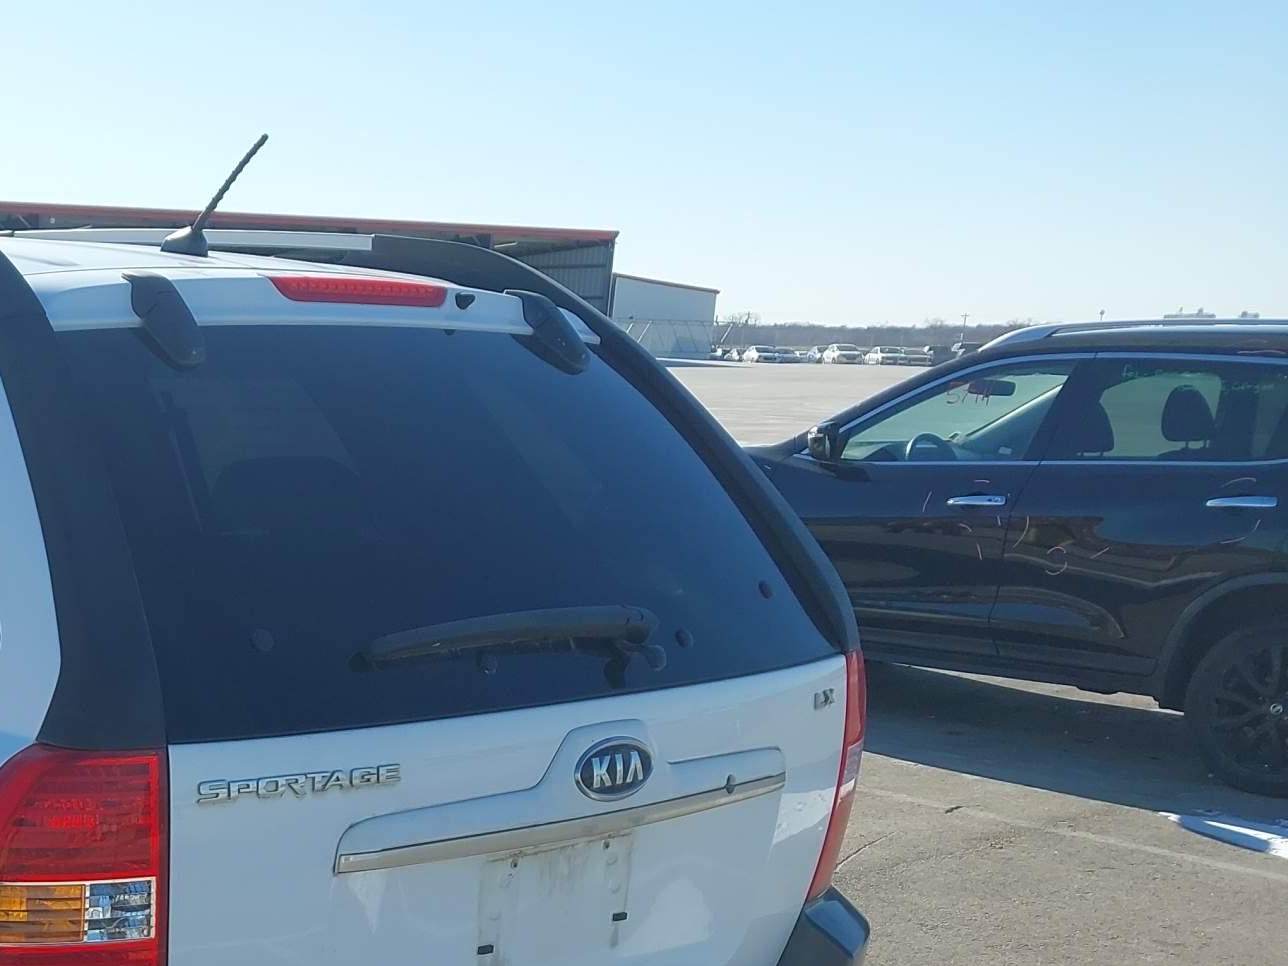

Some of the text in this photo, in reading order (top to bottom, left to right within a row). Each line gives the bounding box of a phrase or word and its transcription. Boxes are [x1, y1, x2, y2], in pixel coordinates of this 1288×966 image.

[814, 688, 836, 711] LX
[194, 762, 402, 804] SPORTAGE
[591, 750, 644, 789] KIA
